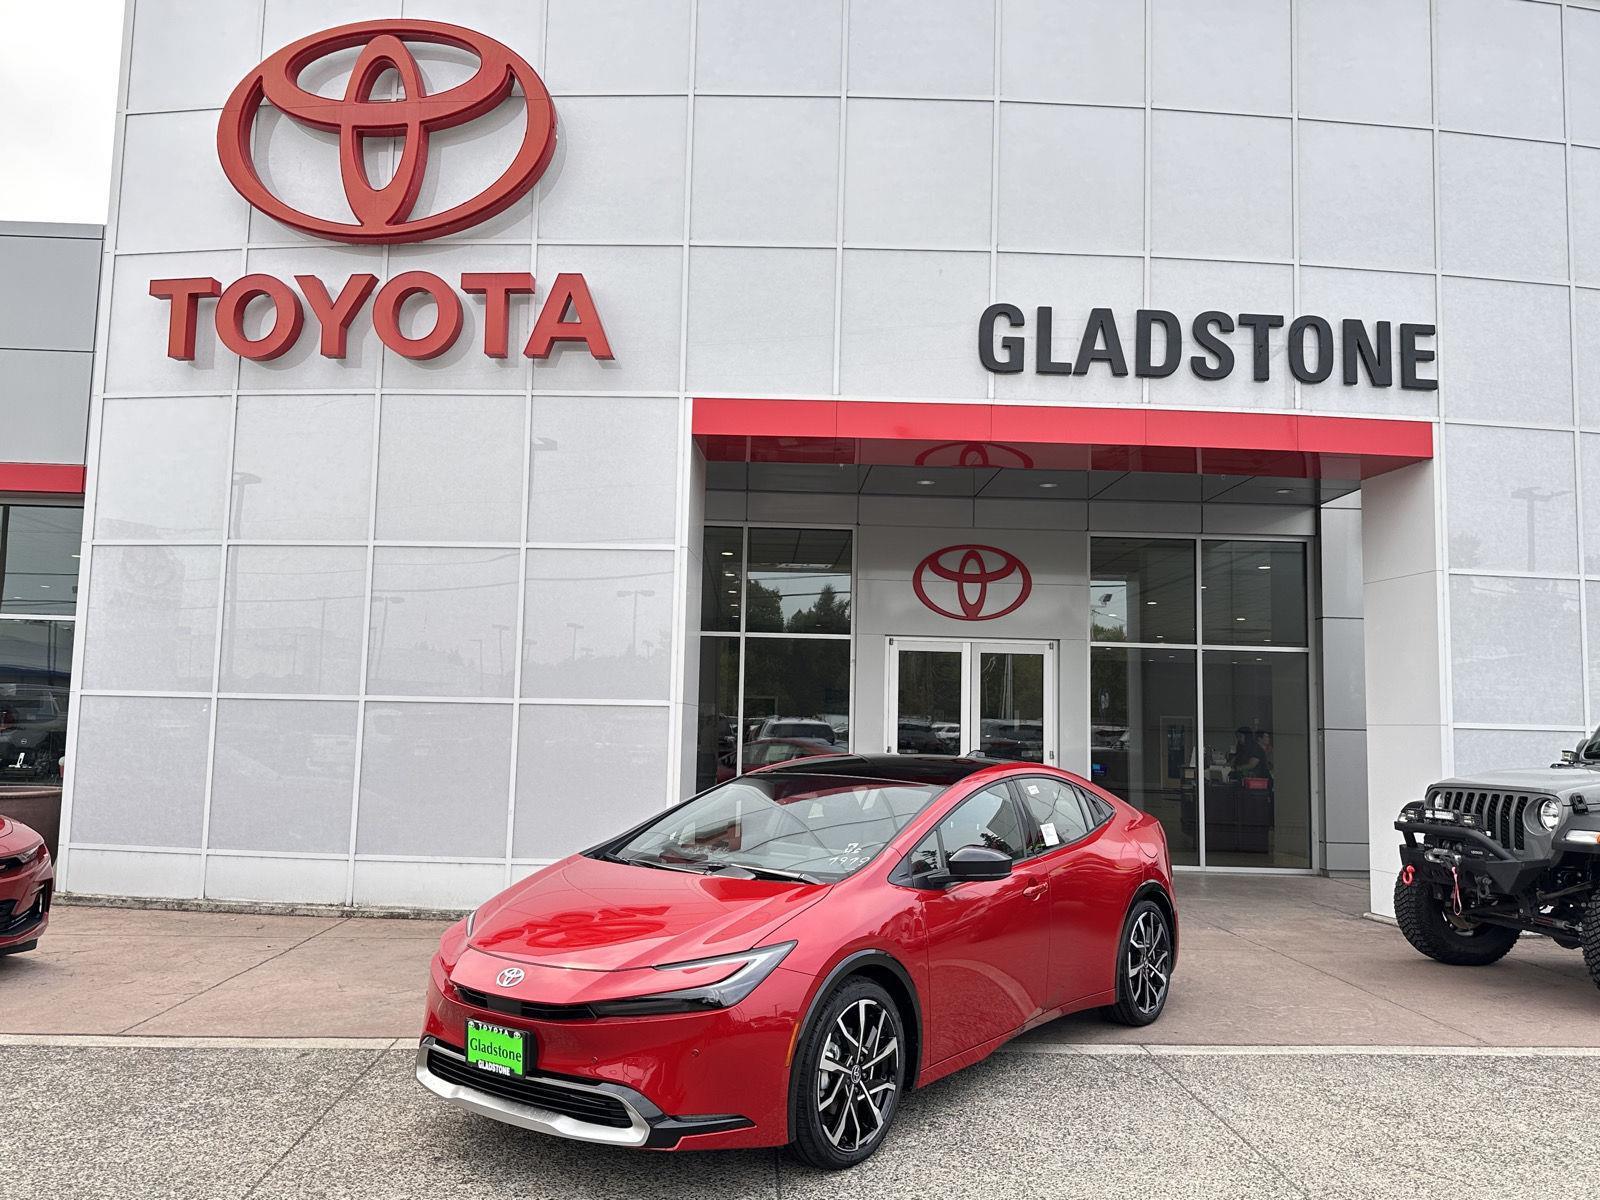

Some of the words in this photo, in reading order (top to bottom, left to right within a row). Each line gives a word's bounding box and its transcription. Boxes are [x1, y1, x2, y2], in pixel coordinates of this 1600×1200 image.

[149, 271, 615, 361] TOYOTA
[978, 302, 1438, 391] GLADSTONE
[478, 1022, 509, 1036] TOYOTA
[469, 1037, 522, 1062] Gladstone
[477, 1060, 511, 1076] GLADSTONE
